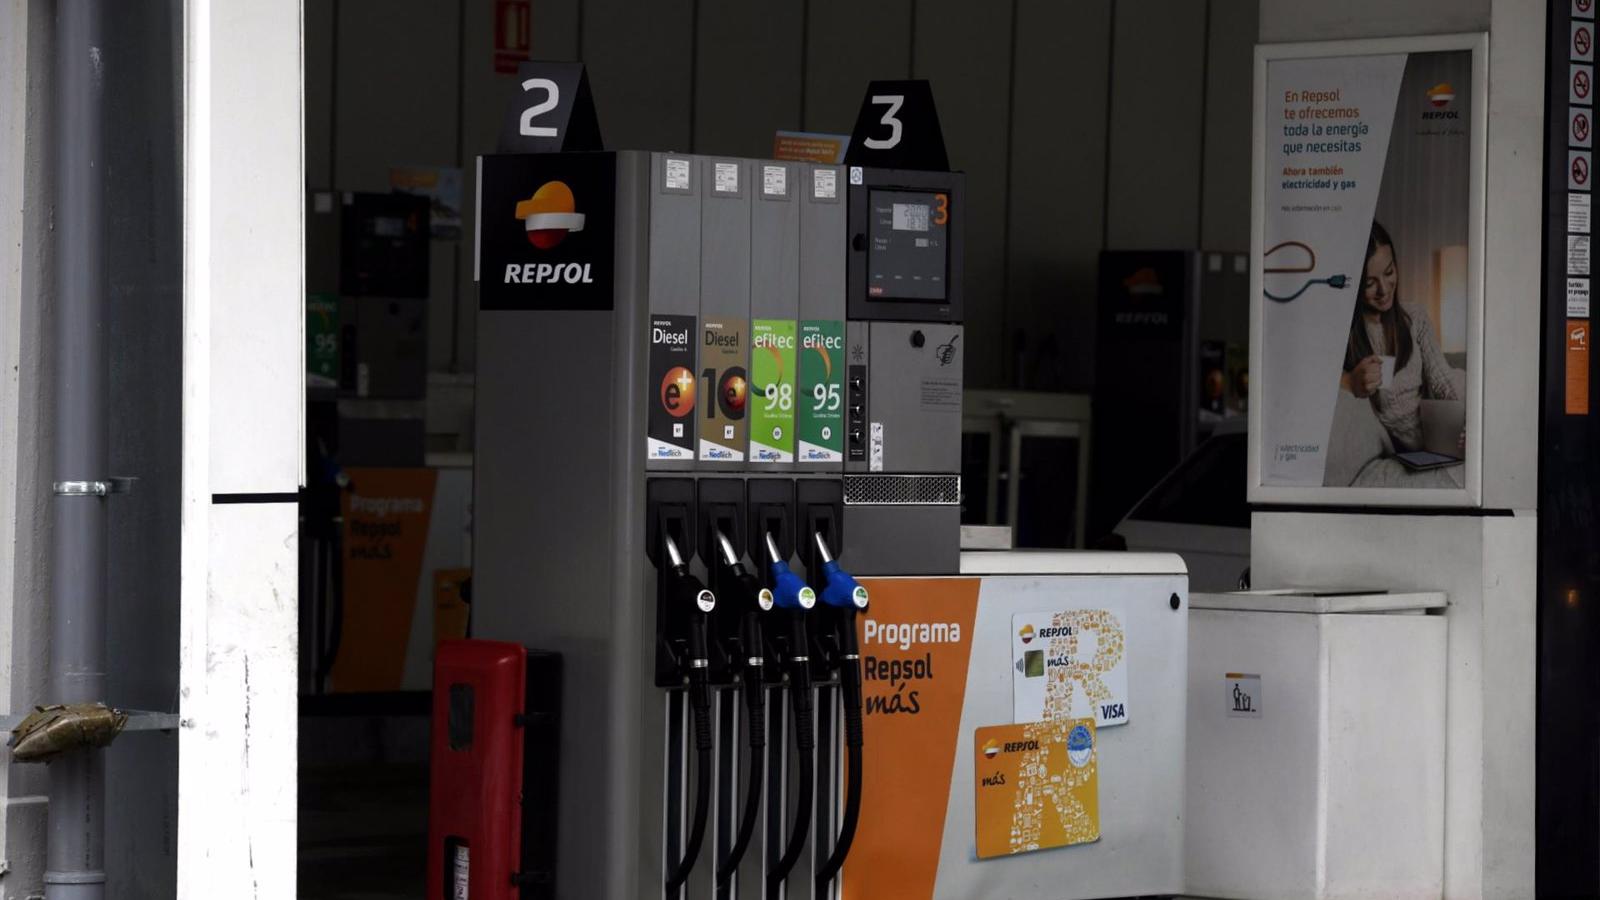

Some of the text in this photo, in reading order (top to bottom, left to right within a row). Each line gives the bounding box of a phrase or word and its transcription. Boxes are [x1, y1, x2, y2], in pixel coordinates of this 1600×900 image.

[1285, 88, 1340, 104] En Repsol
[519, 78, 560, 137] 2
[1285, 106, 1359, 120] te ofrecemos
[864, 95, 904, 151] 3
[1422, 112, 1459, 120] REPSOL
[1284, 121, 1369, 138] toda la energía
[1283, 140, 1362, 156] que necesitas
[1283, 165, 1344, 176] Ahora también
[1282, 179, 1356, 190] electricidad y gas
[935, 193, 948, 225] 3
[504, 262, 594, 286] REPSOL
[315, 335, 337, 353] 95
[653, 328, 688, 345] Diesel
[705, 330, 739, 347] Diesel
[754, 333, 794, 349] efitec
[803, 333, 842, 349] efitec
[764, 383, 793, 411] 98
[813, 383, 841, 411] 95
[864, 620, 961, 650] Programa
[1039, 626, 1072, 638] REPSOL
[1047, 653, 1070, 667] más
[864, 655, 933, 685] Repsol
[865, 683, 921, 716] más
[1101, 704, 1125, 720] VISA
[1004, 740, 1040, 753] REPSOL
[982, 772, 1006, 787] más
